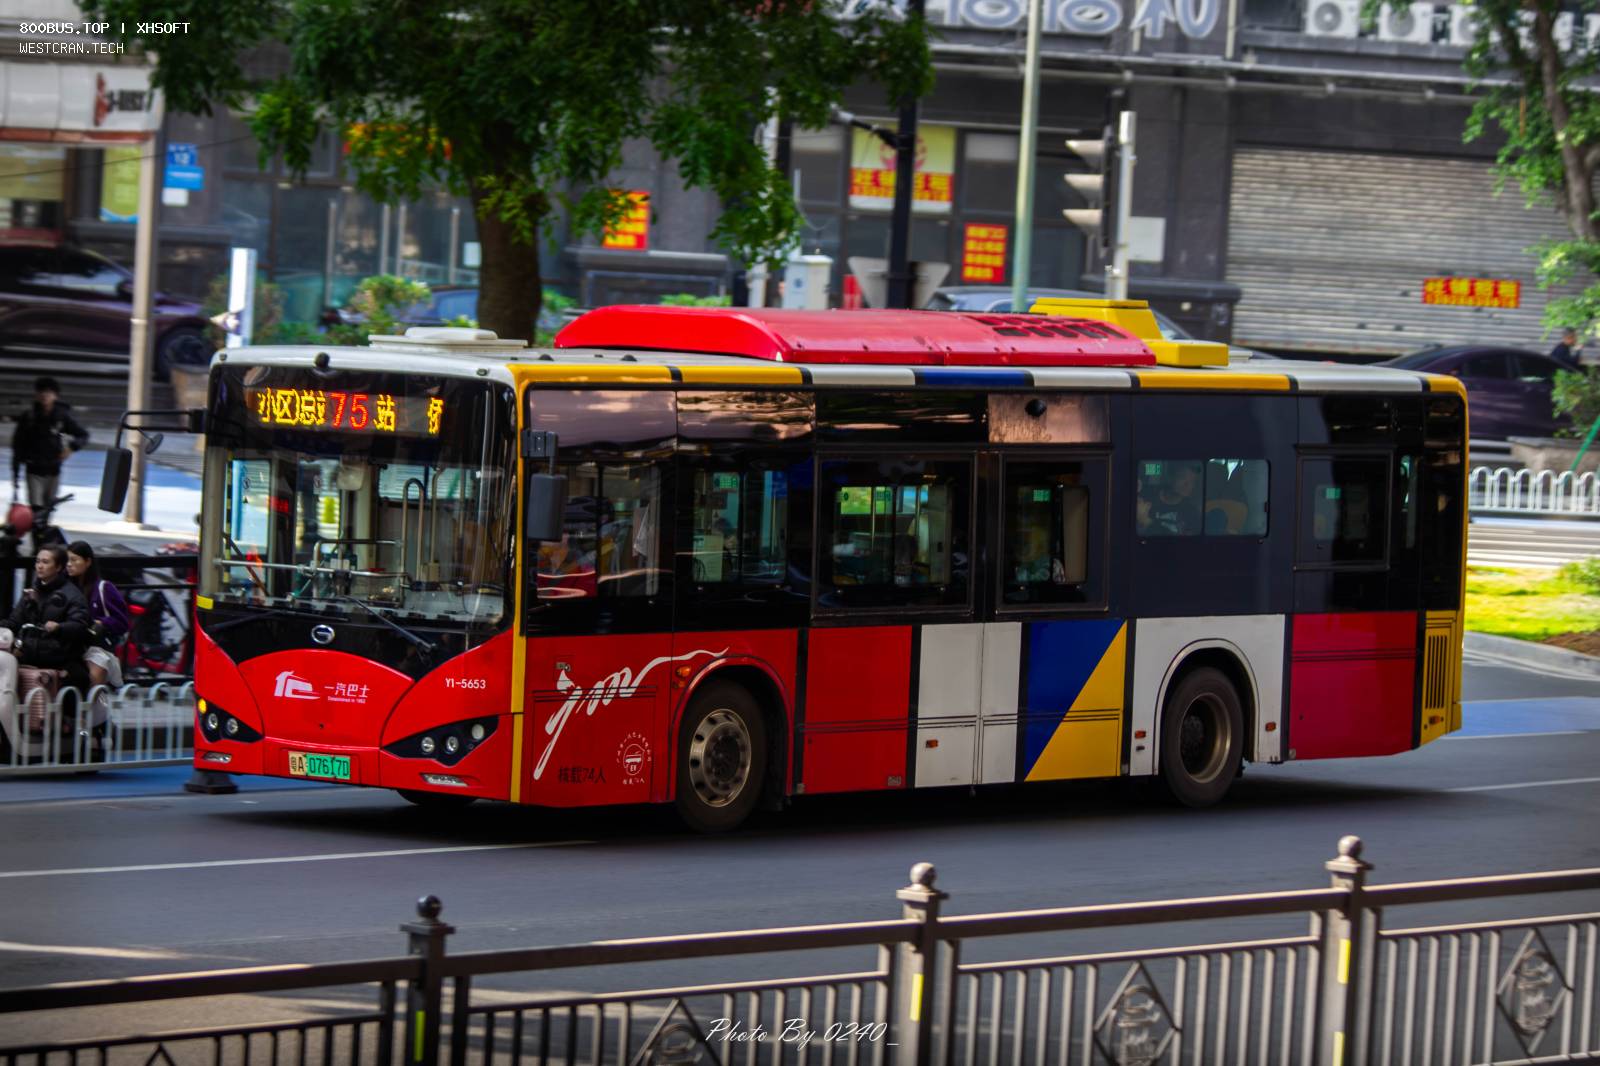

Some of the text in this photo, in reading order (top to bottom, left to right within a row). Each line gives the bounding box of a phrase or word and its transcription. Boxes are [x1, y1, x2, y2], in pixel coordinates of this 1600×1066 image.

[329, 391, 369, 430] 75
[324, 682, 371, 698] 一汽巴士
